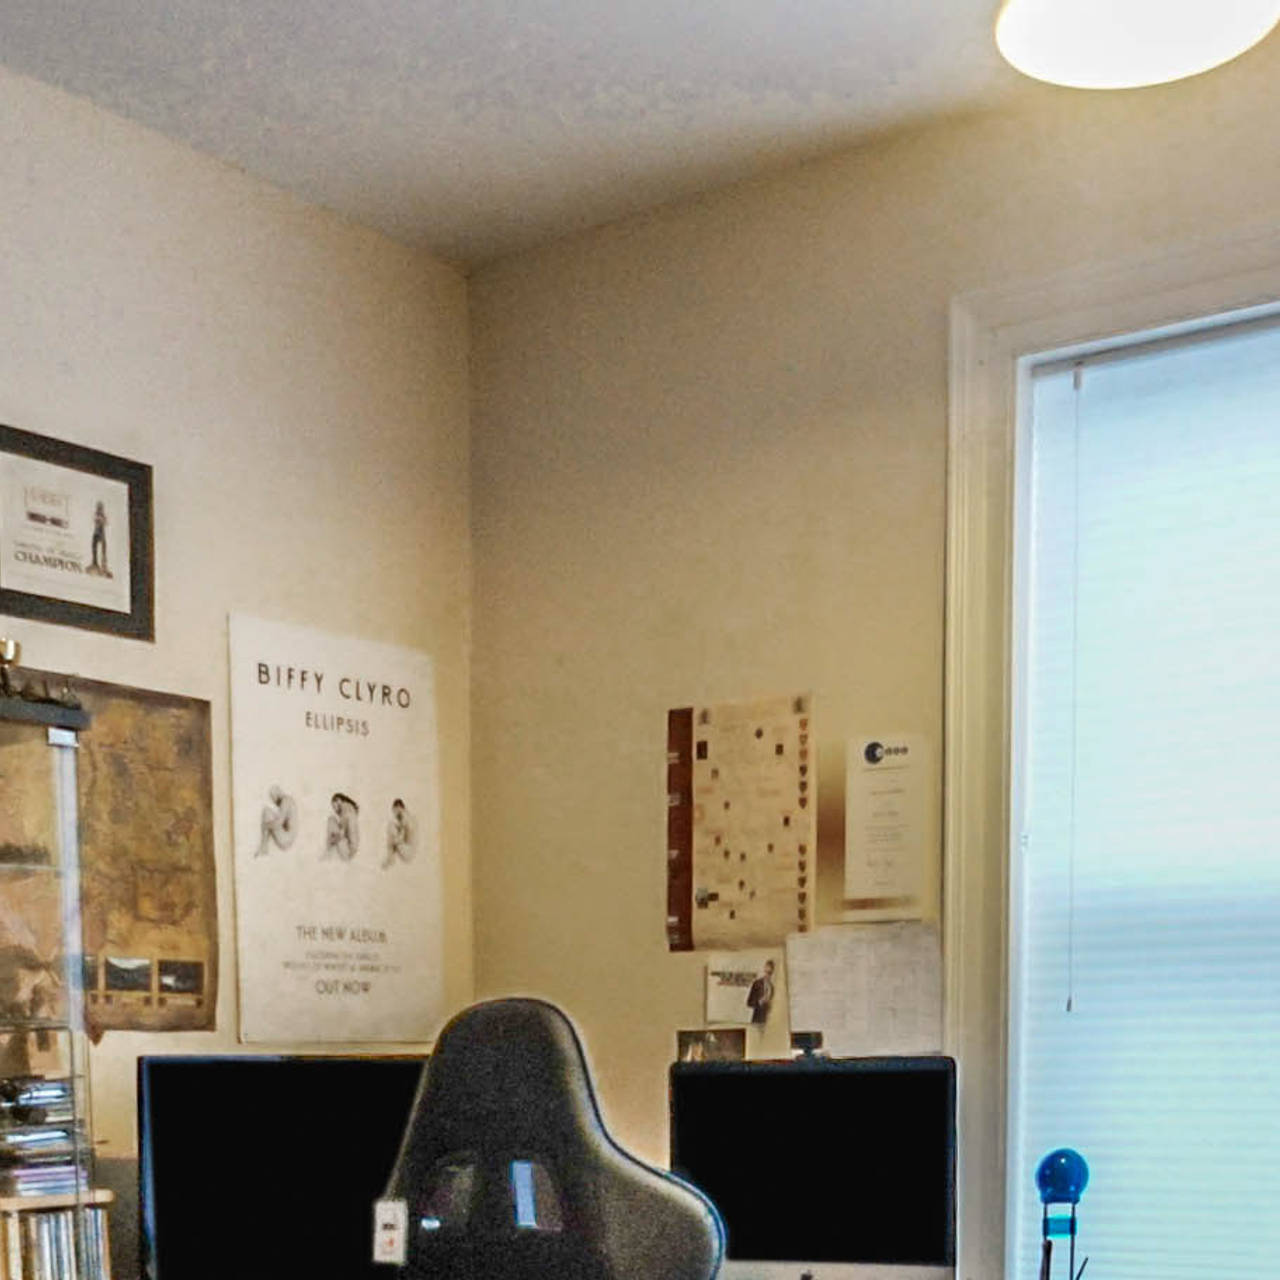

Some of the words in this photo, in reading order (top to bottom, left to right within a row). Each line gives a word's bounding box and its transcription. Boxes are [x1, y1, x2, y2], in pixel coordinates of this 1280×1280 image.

[14, 551, 83, 574] CHAMPION
[257, 662, 324, 694] BIFFY
[338, 677, 411, 709] CLYRO
[305, 710, 370, 737] ELLIPSIS
[295, 925, 318, 941] THE
[321, 926, 345, 942] NEW
[349, 928, 387, 944] ALBUM
[315, 979, 340, 995] OUT
[342, 980, 371, 995] NOW
